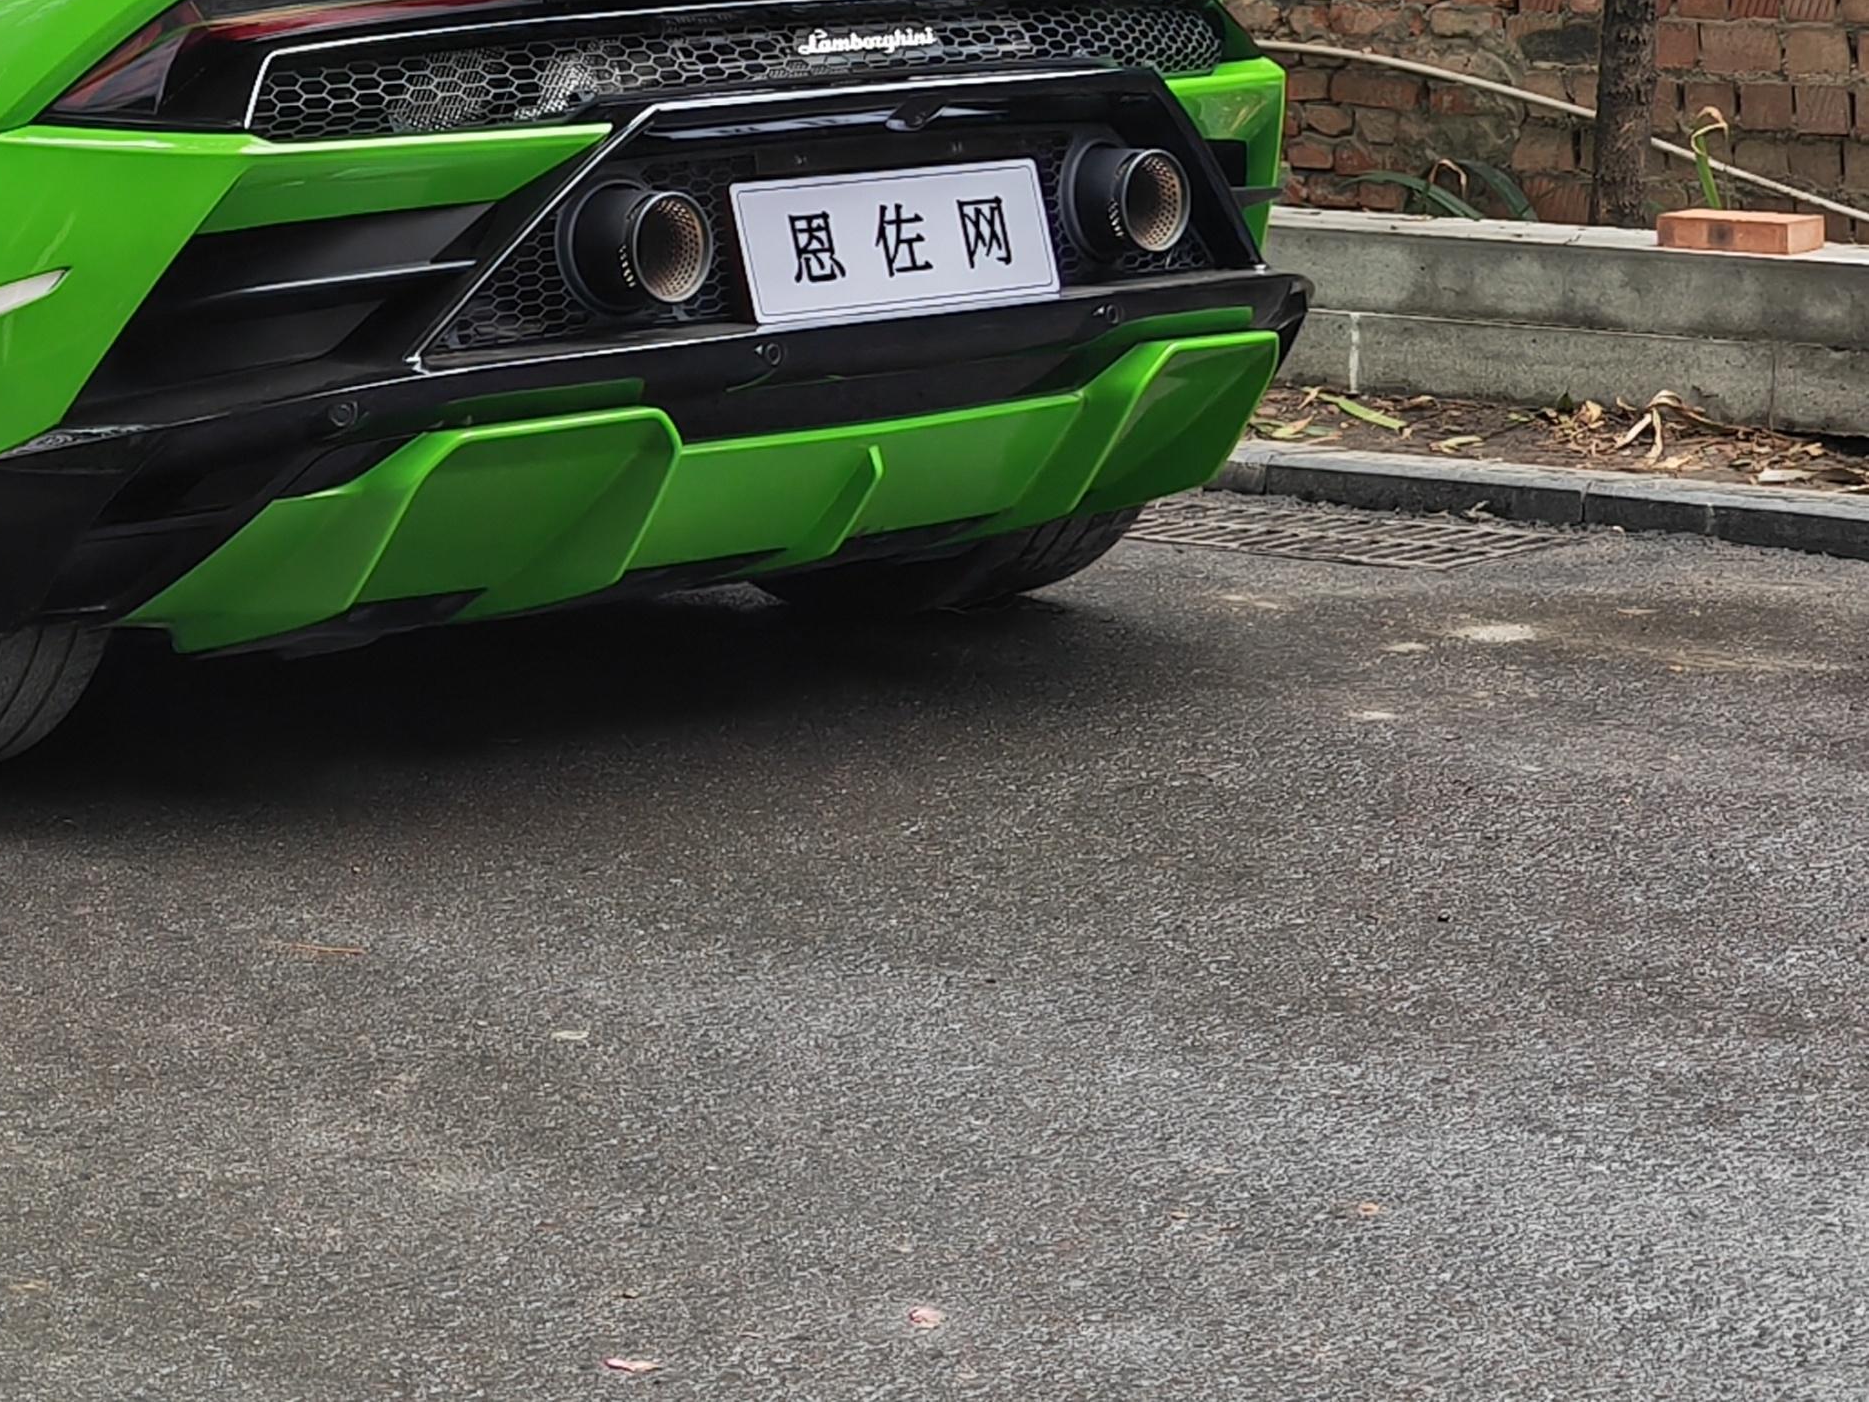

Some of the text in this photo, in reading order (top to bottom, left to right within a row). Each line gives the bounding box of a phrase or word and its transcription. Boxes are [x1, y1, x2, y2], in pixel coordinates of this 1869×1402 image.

[797, 26, 938, 55] Lamborghini
[788, 195, 1013, 284] 恩佐网
